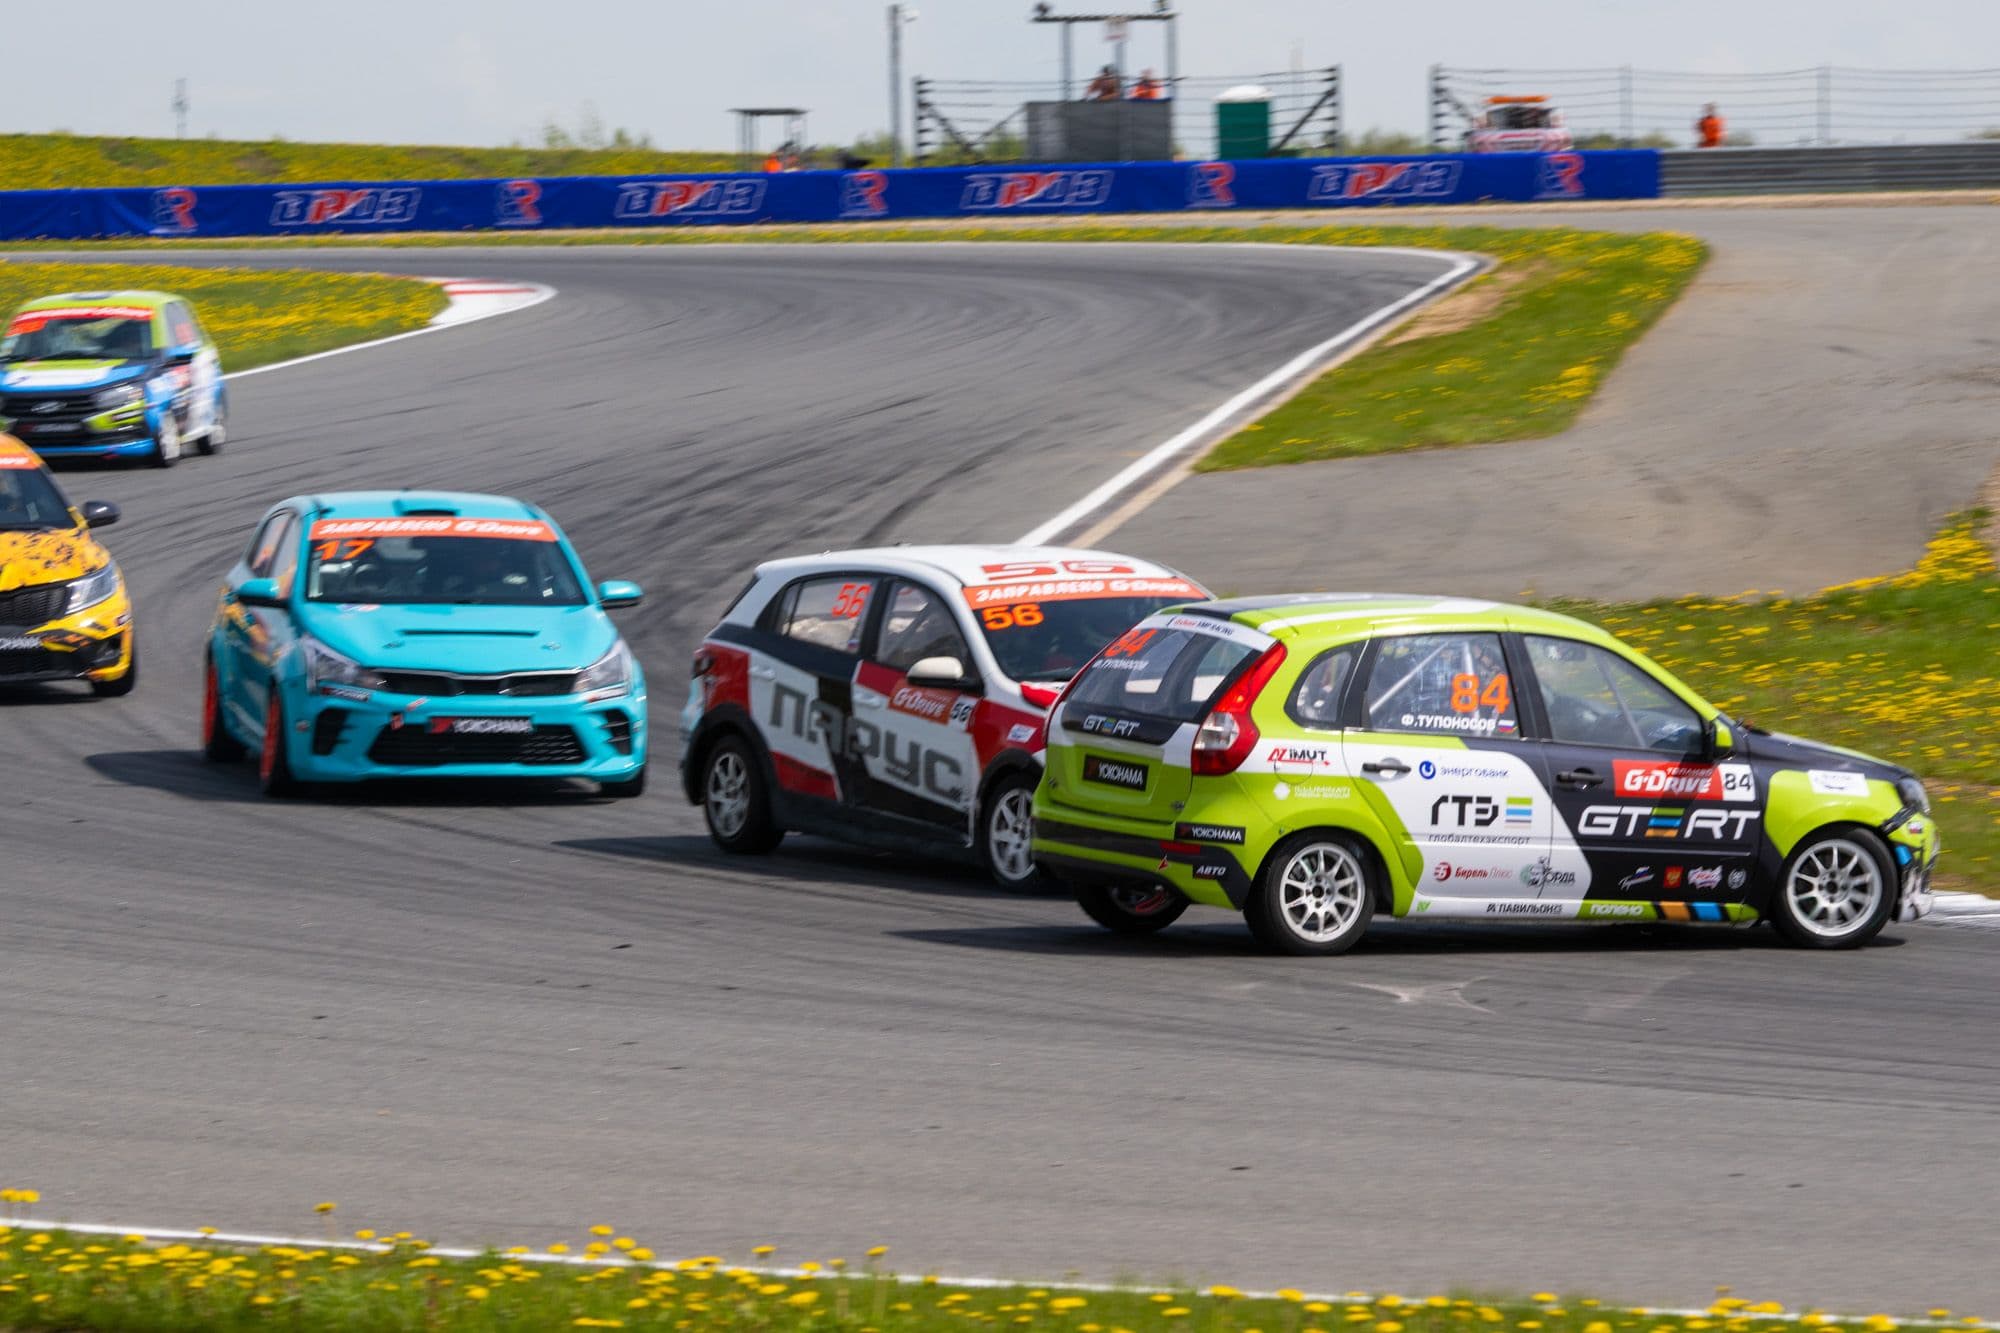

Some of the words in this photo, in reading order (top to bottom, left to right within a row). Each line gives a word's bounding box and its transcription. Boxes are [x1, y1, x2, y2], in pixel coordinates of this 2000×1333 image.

[314, 539, 374, 561] 17
[831, 582, 872, 619] 56
[982, 603, 1044, 632] 56
[1103, 627, 1158, 657] 84
[1450, 672, 1511, 715] 84
[769, 682, 963, 803] ПАРУС
[1099, 761, 1144, 786] YOKOHAMA
[1724, 772, 1752, 791] 84
[1430, 795, 1499, 827] ГТЭ
[1191, 826, 1242, 841] YOKOHAMA
[1196, 864, 1227, 877] АВТО
